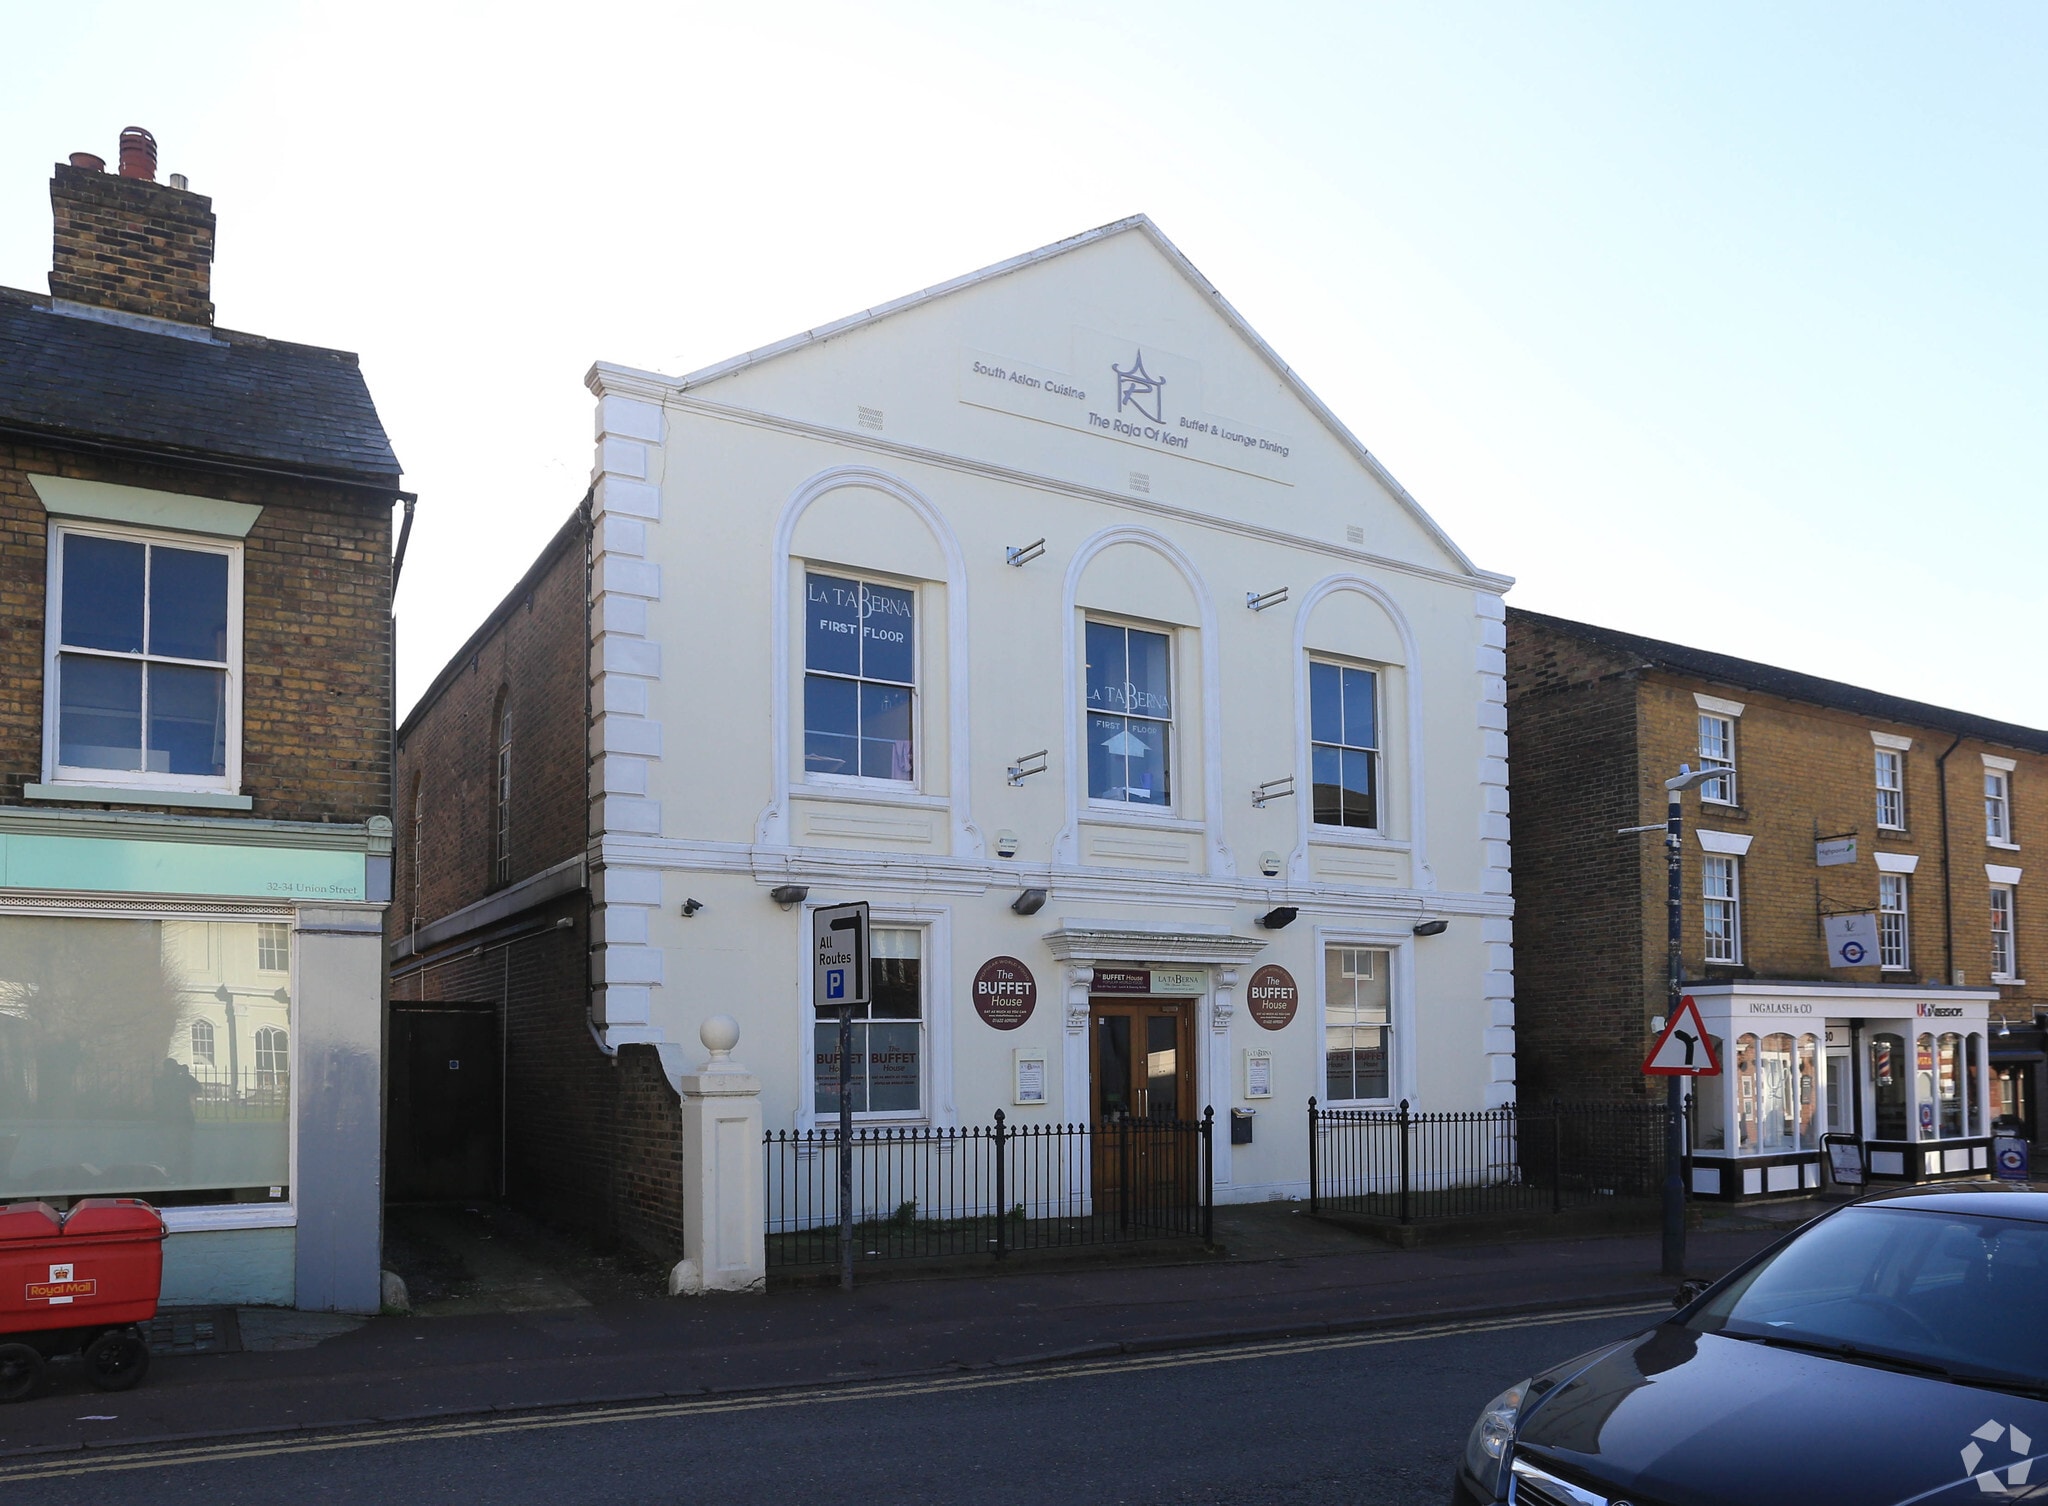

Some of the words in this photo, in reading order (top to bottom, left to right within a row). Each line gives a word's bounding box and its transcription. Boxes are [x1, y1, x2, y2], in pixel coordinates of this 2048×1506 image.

[973, 361, 1006, 380] South
[1009, 371, 1040, 389] Asian
[1044, 381, 1086, 400] Cuisine
[1089, 412, 1110, 429] The
[1113, 419, 1141, 438] Raja
[1144, 426, 1158, 441] Of
[1162, 432, 1189, 449] Kent
[1180, 417, 1208, 433] Buffet
[1211, 427, 1218, 435] &
[1221, 429, 1257, 447] Lounge
[1259, 439, 1290, 457] Dining
[820, 619, 857, 635] FIRST
[864, 627, 904, 643] FLOOR
[1096, 720, 1121, 730] FIRST
[1132, 725, 1157, 735] FLOOR
[267, 882, 293, 891] 32-34
[296, 883, 327, 893] Union
[329, 884, 357, 894] Street
[820, 936, 833, 950] All
[819, 953, 852, 966] Routes
[996, 969, 1014, 980] The
[1102, 973, 1125, 981] BUFFET
[1266, 976, 1280, 986] The
[830, 973, 841, 996] P
[978, 981, 1032, 995] BUFFET
[1251, 986, 1295, 999] BUFFET
[991, 995, 1023, 1006] House
[1262, 999, 1288, 1010] House
[1749, 1003, 1793, 1014] INGALASH
[1800, 1004, 1812, 1014] CO
[816, 1053, 863, 1064] BUFET
[871, 1052, 916, 1063] BUFFET
[883, 1064, 906, 1072] House
[31, 1285, 64, 1296] Royal
[66, 1282, 91, 1293] Mail
